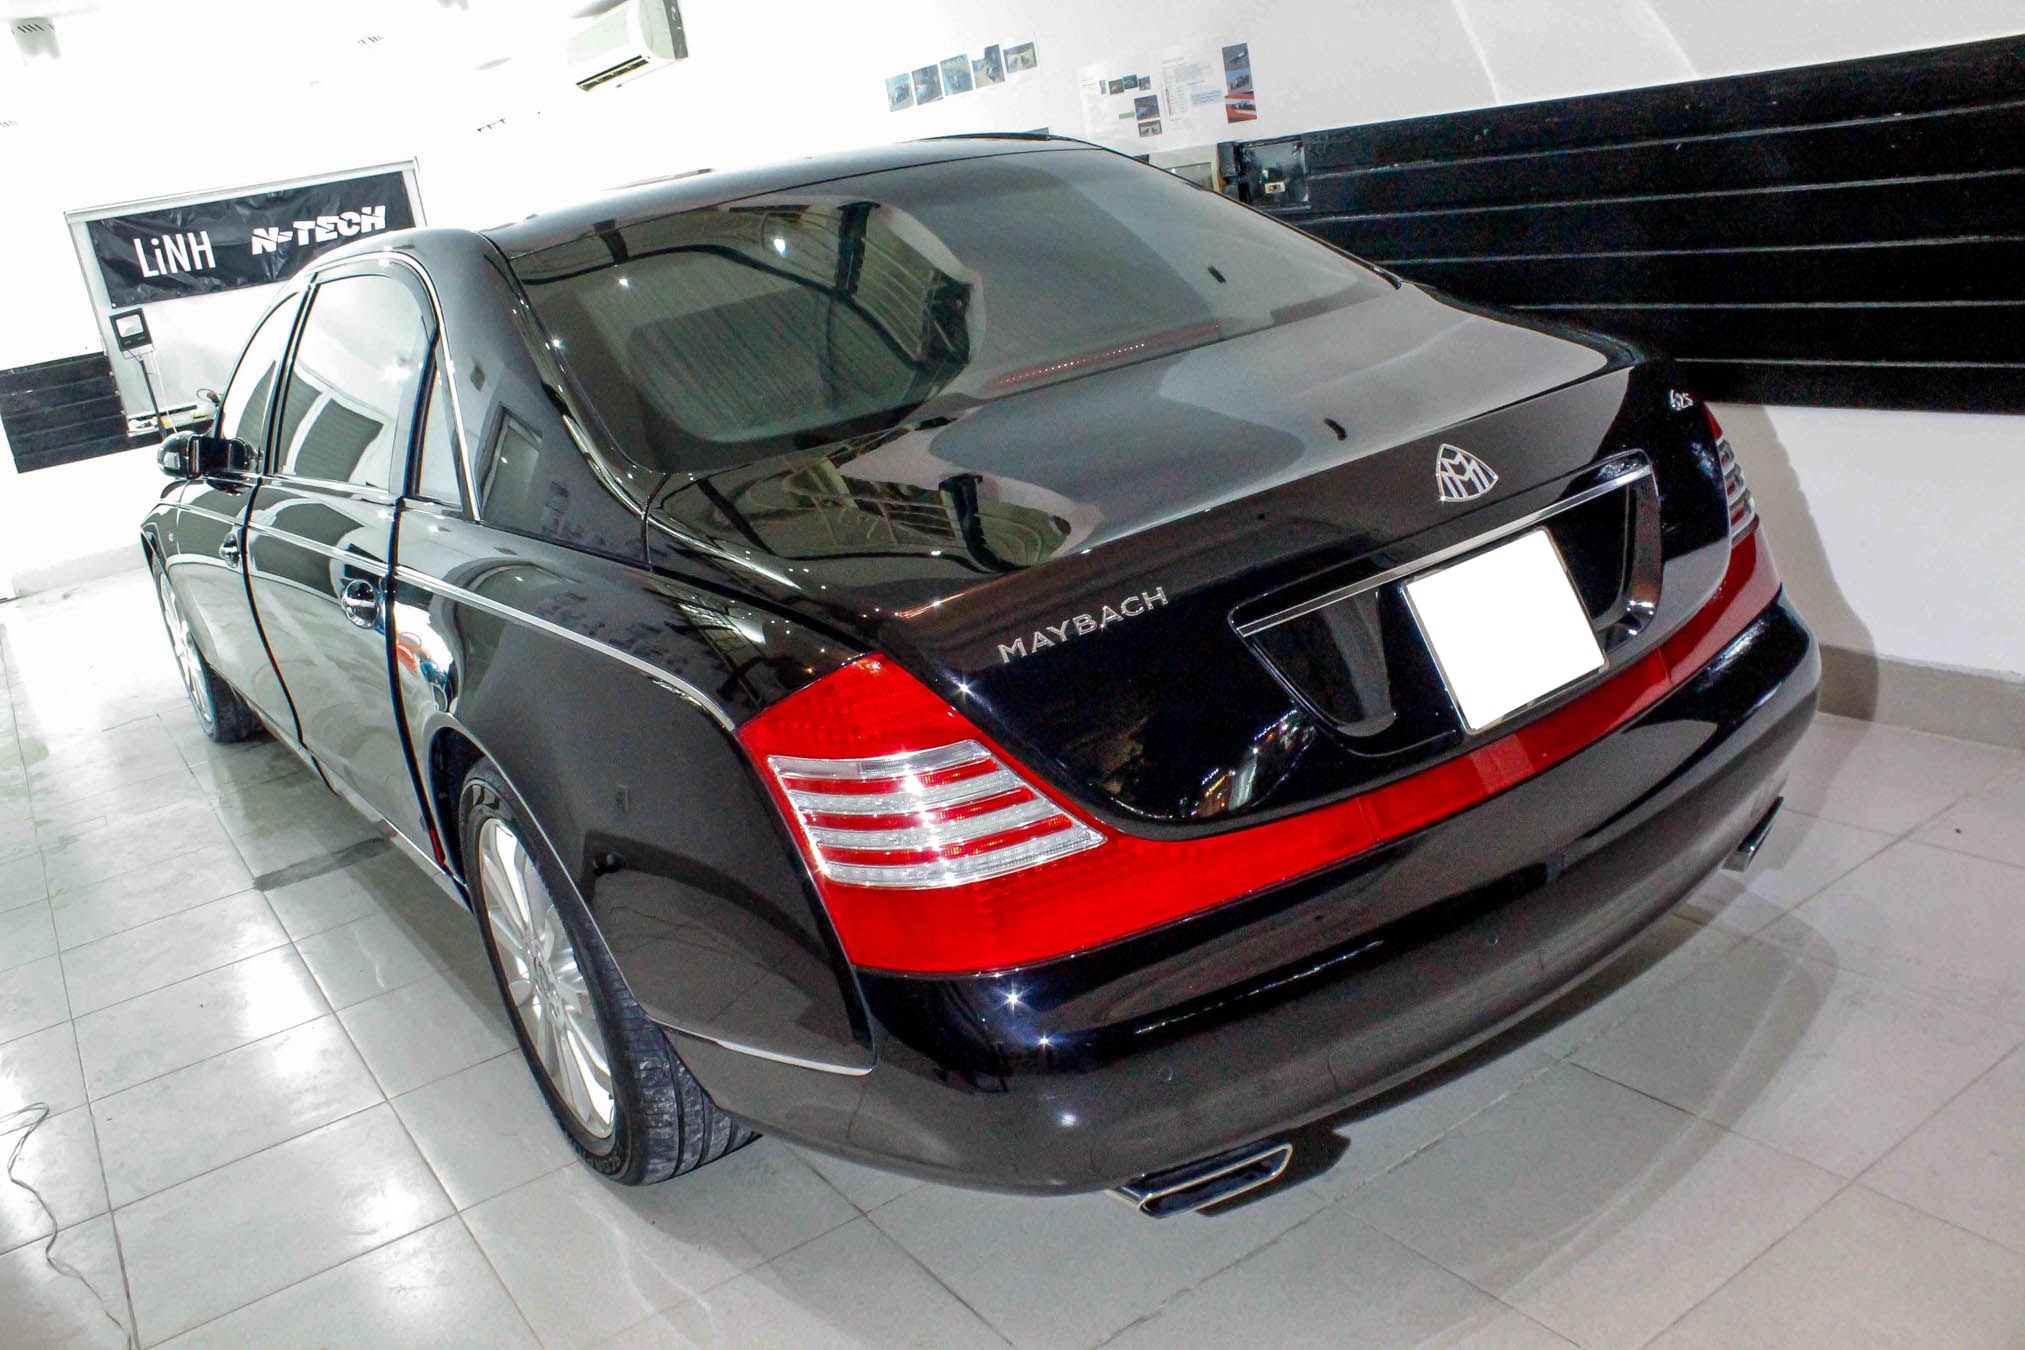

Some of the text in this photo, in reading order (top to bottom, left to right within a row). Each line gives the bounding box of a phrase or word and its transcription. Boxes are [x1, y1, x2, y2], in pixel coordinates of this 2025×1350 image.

[133, 205, 386, 278] LiNH N-TECH
[997, 586, 1168, 664] MAYBACH
